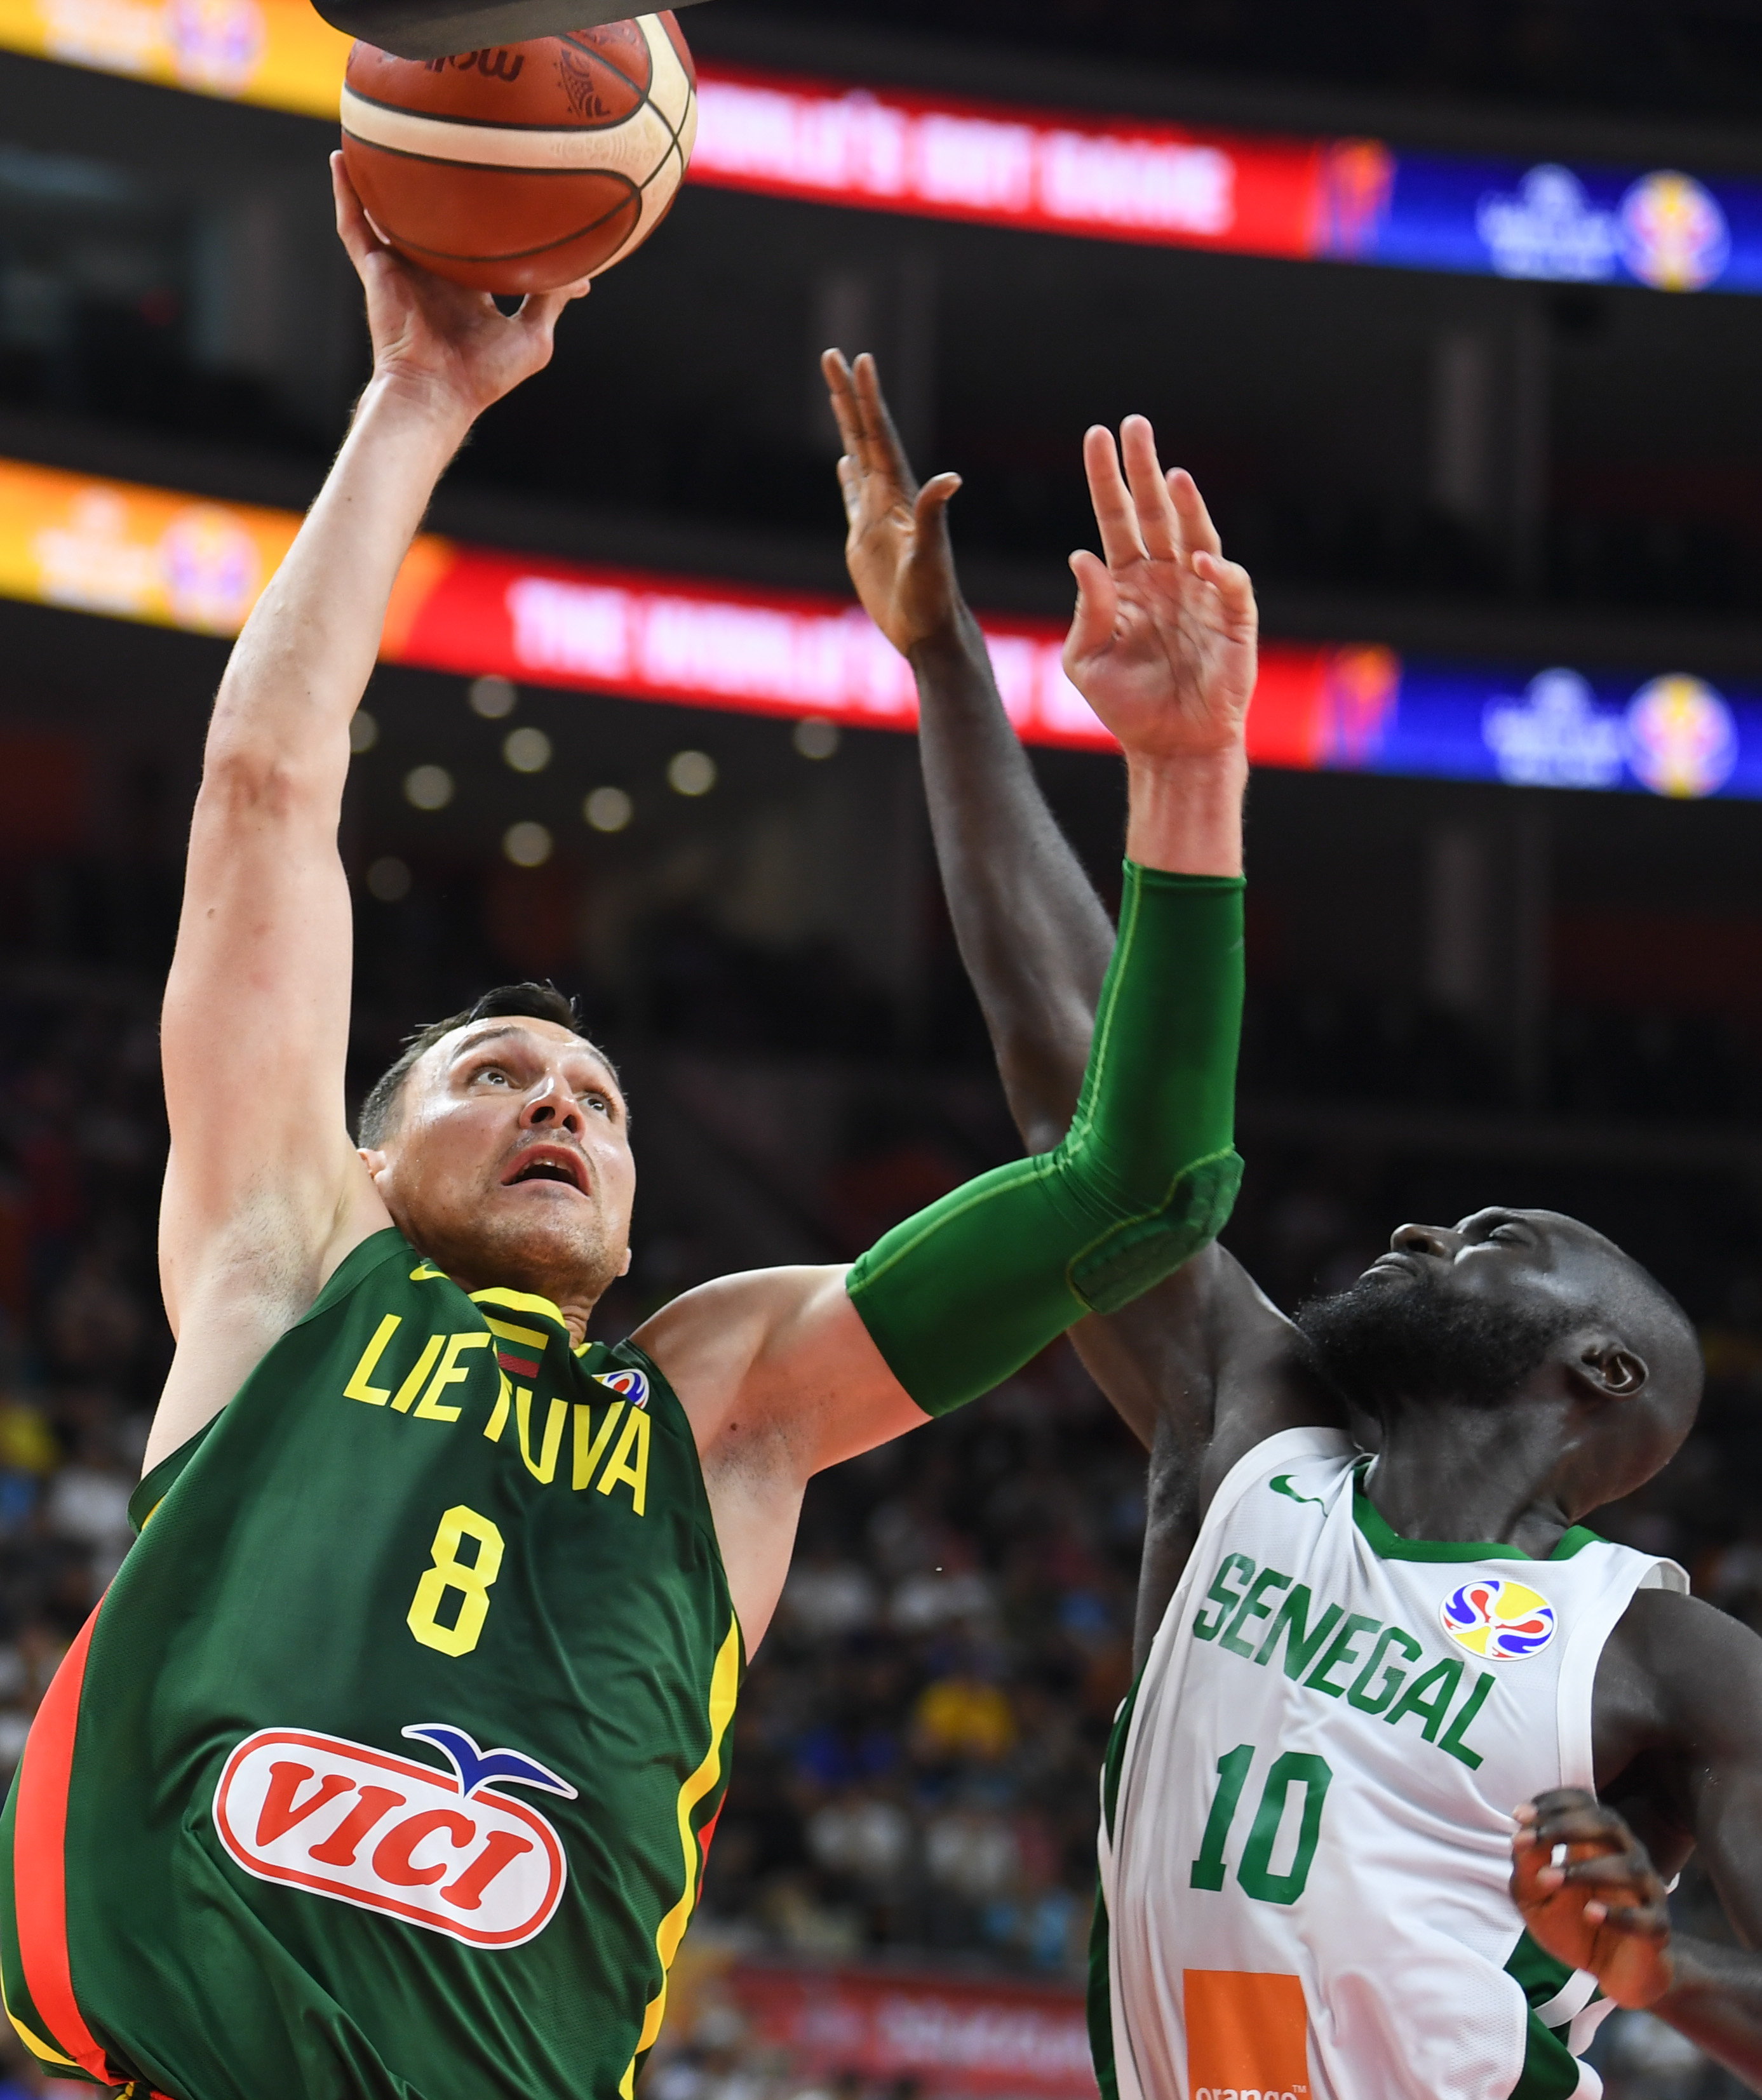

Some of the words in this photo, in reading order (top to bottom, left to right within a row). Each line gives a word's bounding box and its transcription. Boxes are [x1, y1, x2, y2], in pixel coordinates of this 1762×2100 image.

[343, 1313, 650, 1517] LIETUVA
[407, 1504, 505, 1657] 8
[1192, 1553, 1496, 1771] SENEGAL
[255, 1761, 534, 1910] VICI
[1190, 1744, 1333, 1905] 10
